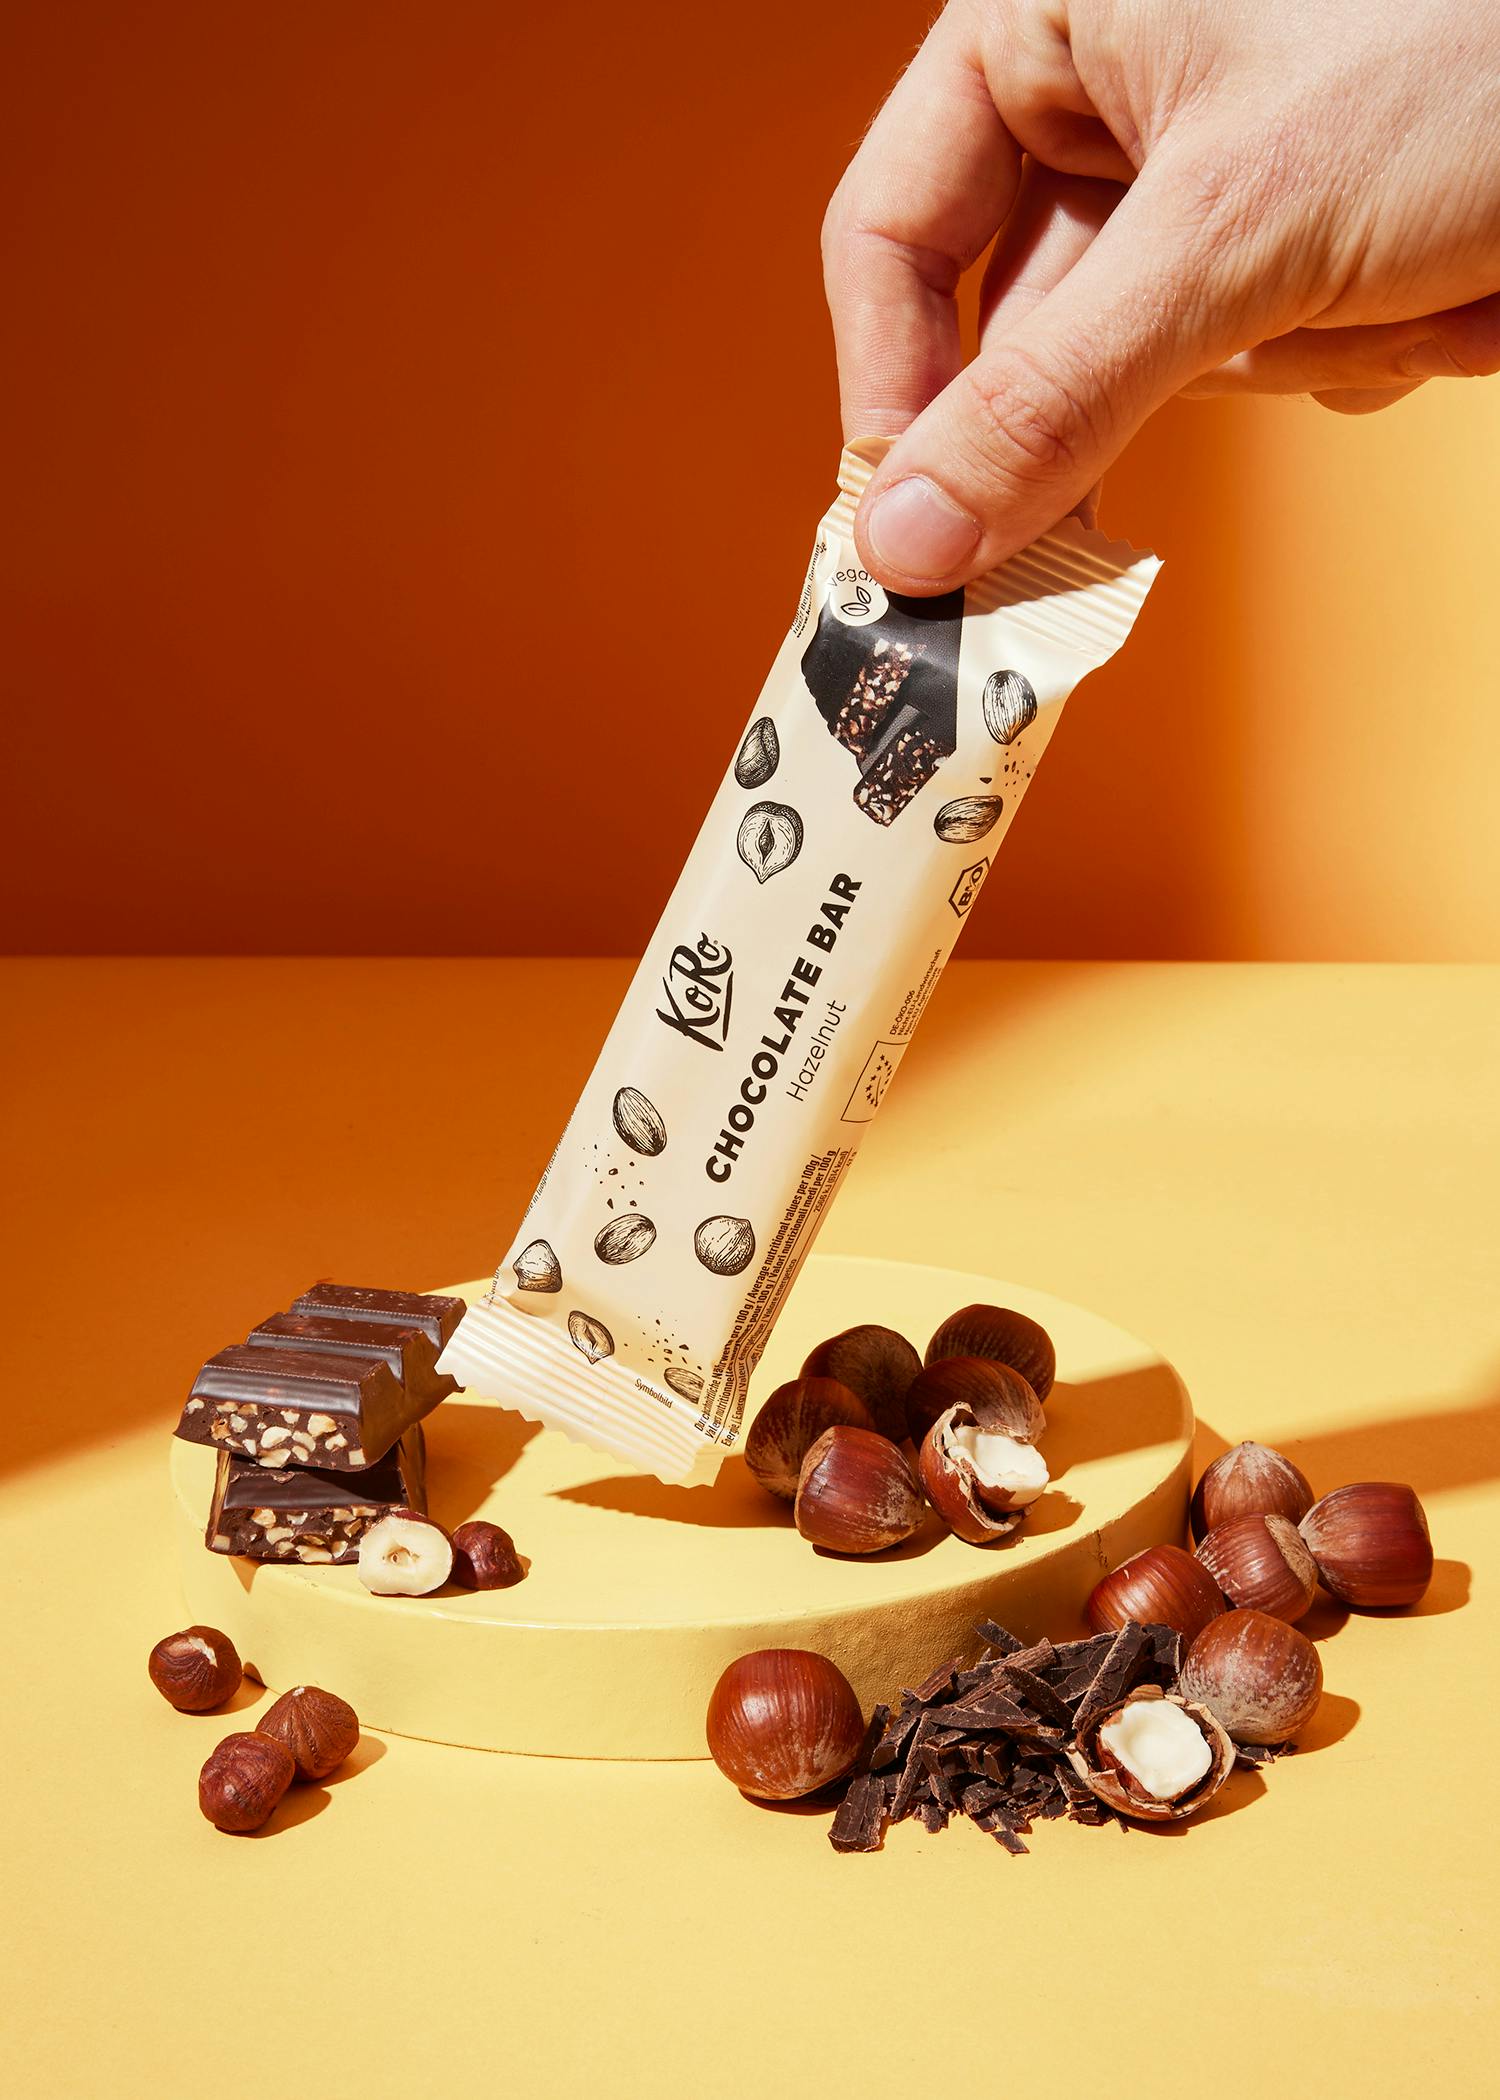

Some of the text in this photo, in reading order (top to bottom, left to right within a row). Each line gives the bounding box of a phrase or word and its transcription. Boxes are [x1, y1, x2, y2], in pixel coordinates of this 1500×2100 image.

[890, 991, 915, 1035] DE-ÖKO-006
[705, 873, 862, 1183] CHOCOLATE BAR
[786, 1000, 846, 1101] Hazelnut
[818, 1157, 831, 1171] 100
[813, 1173, 824, 1186] per
[804, 1187, 818, 1207] medi
[782, 1209, 808, 1254] nutrizionali
[735, 1310, 749, 1323] 100
[747, 1266, 770, 1298] Average
[765, 1222, 789, 1265] nutritional
[784, 1195, 802, 1221] values
[797, 1180, 808, 1195] per
[769, 1255, 786, 1278] Valori
[757, 1290, 769, 1303] 100
[749, 1305, 762, 1323] pour
[635, 1379, 672, 1408] Symbolbild
